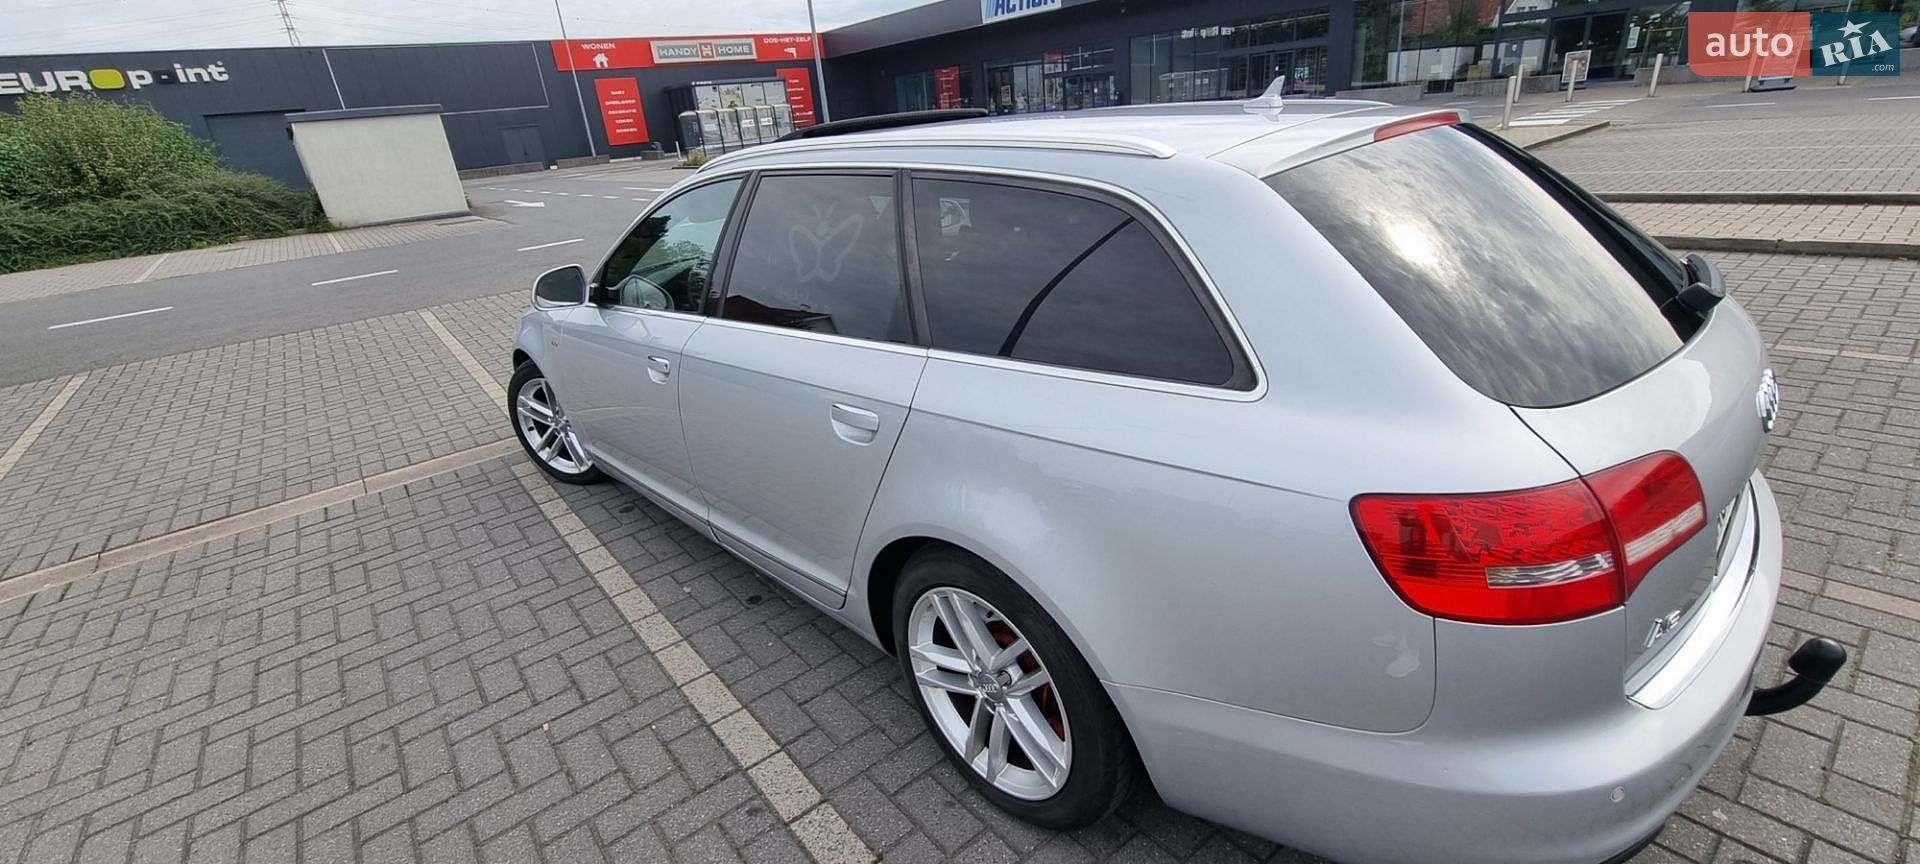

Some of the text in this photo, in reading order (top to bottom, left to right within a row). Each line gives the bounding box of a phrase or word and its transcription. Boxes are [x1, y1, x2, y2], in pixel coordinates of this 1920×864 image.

[994, 0, 1056, 17] ACT
[581, 42, 616, 50] WONEN
[660, 47, 697, 57] HANDY
[718, 45, 750, 54] HOME
